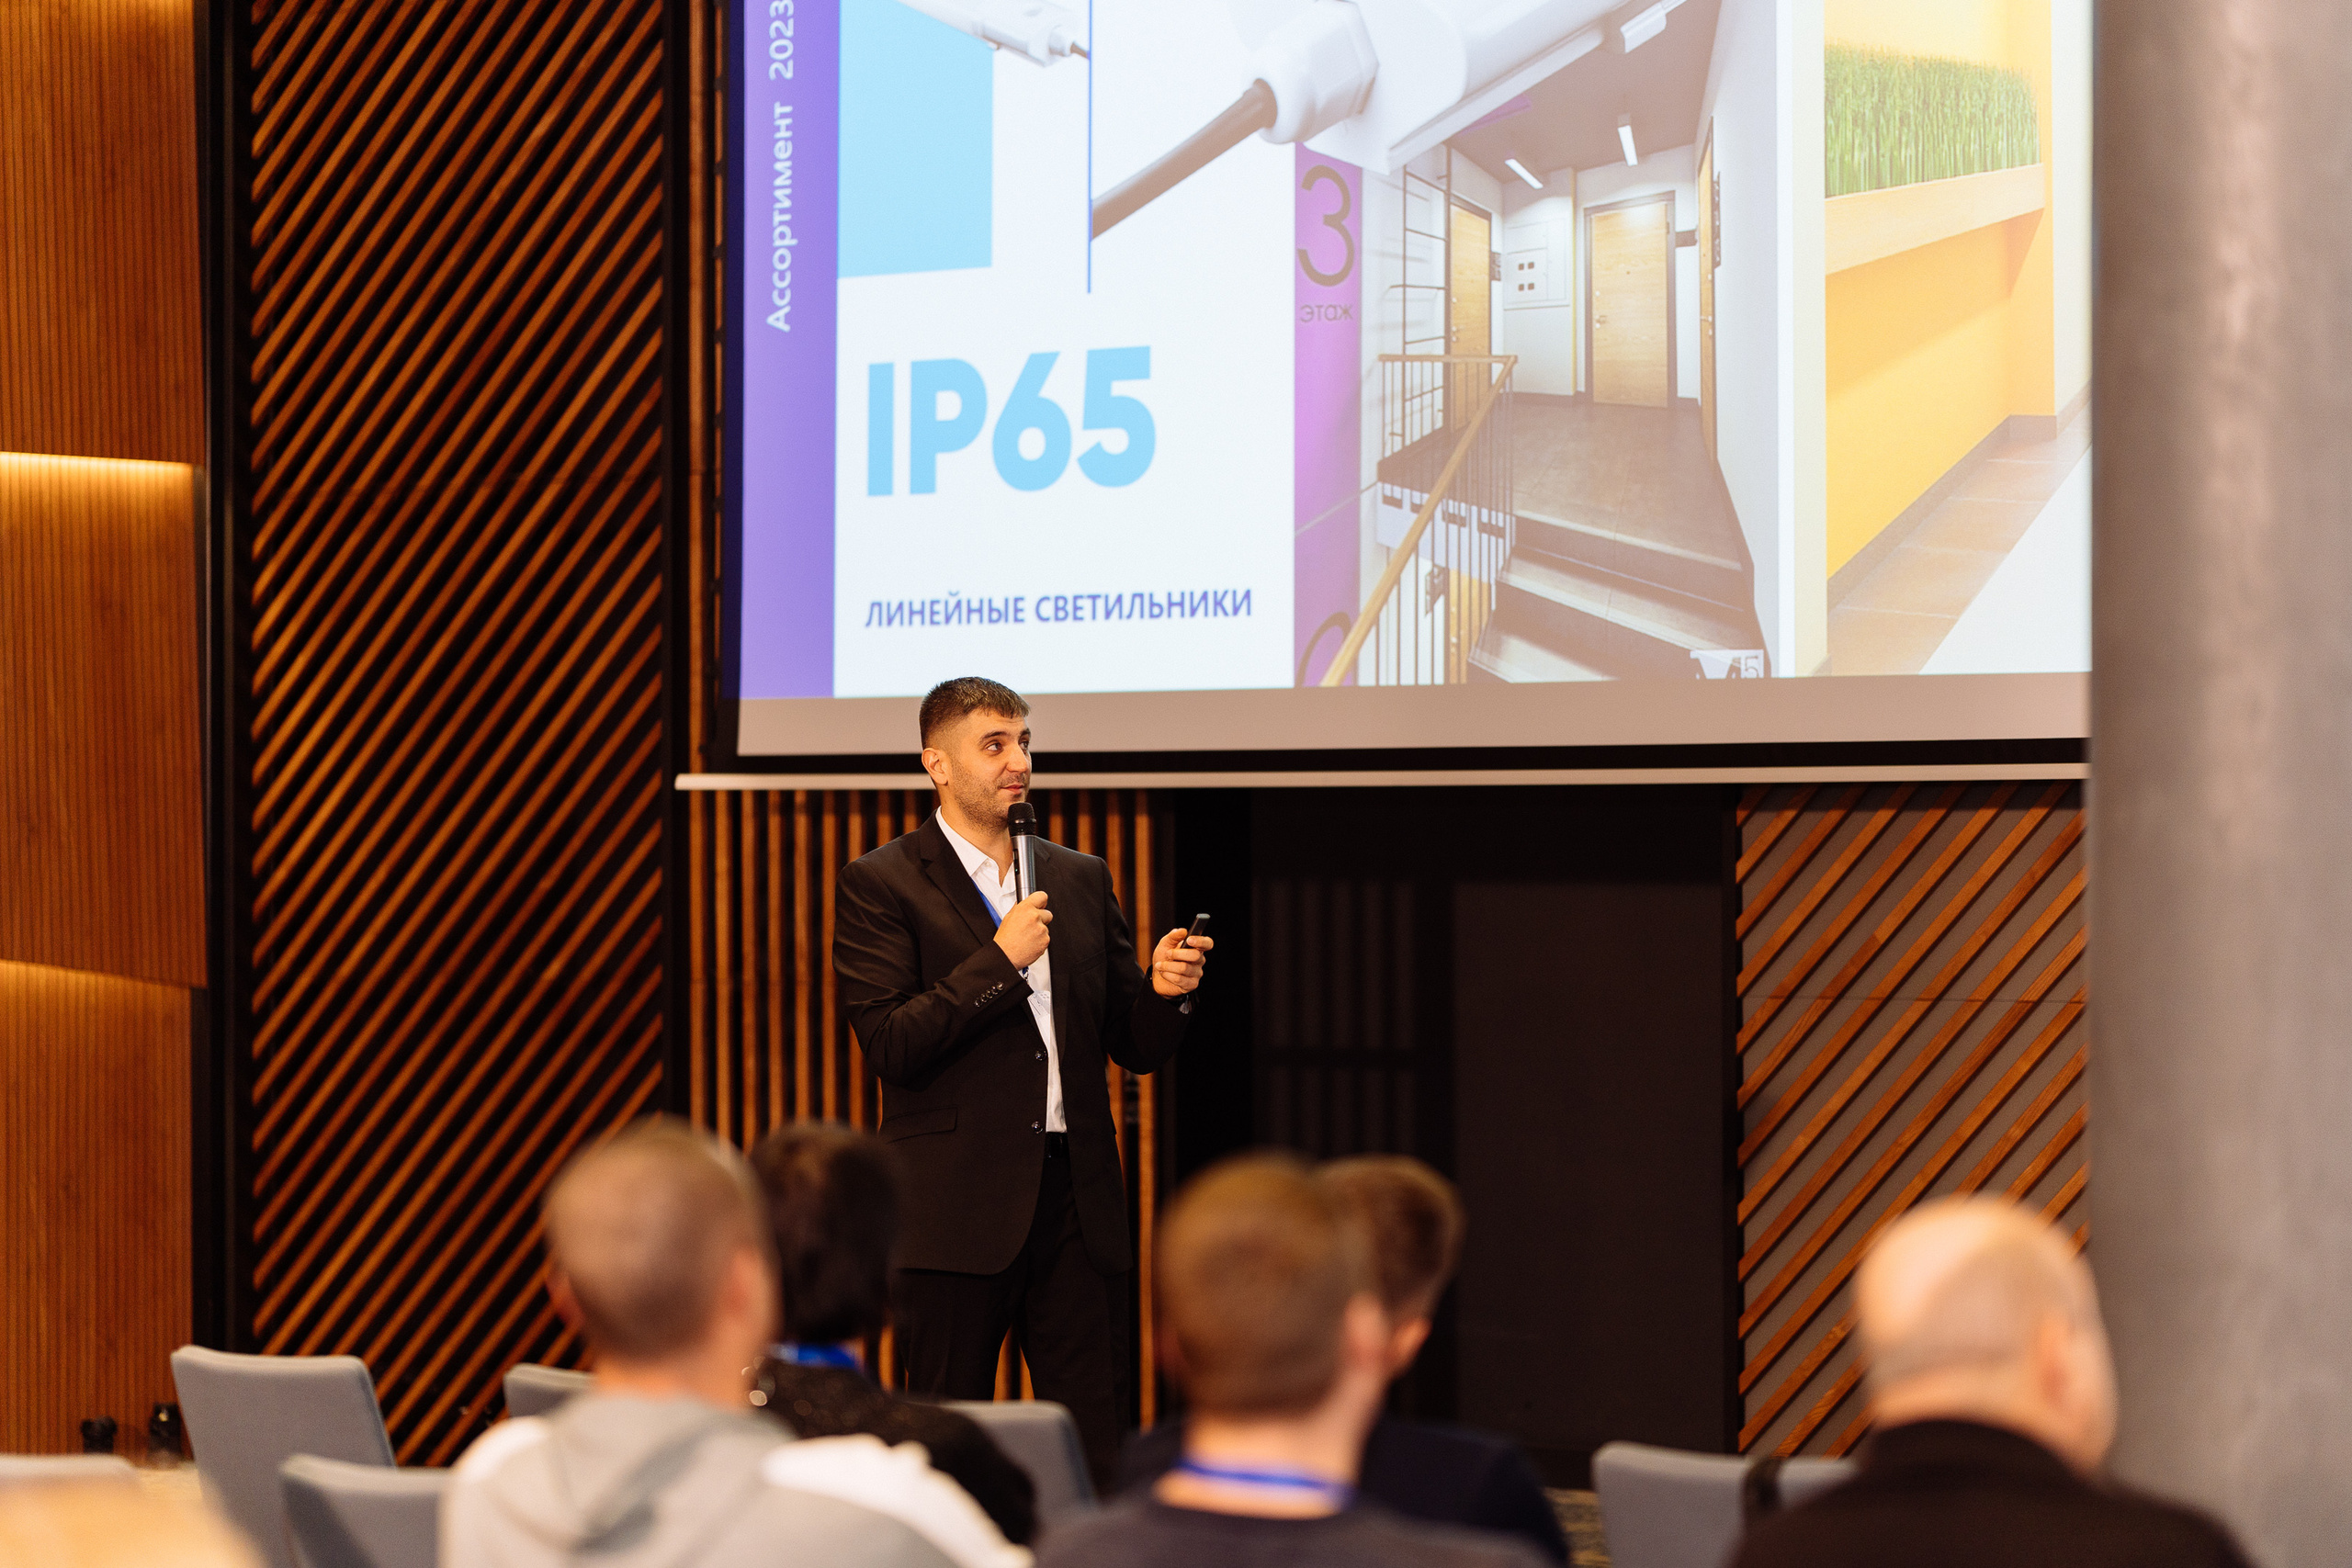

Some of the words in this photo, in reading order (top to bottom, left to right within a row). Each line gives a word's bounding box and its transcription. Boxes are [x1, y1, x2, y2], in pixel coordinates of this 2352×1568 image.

[768, 0, 794, 81] 2023
[766, 101, 798, 333] Ассортимент
[1297, 164, 1355, 287] 3
[866, 345, 1156, 497] IP65
[865, 590, 1025, 628] ЛИНЕЙНЫЕ
[1035, 589, 1251, 623] СВЕТИЛЬНИКИ
